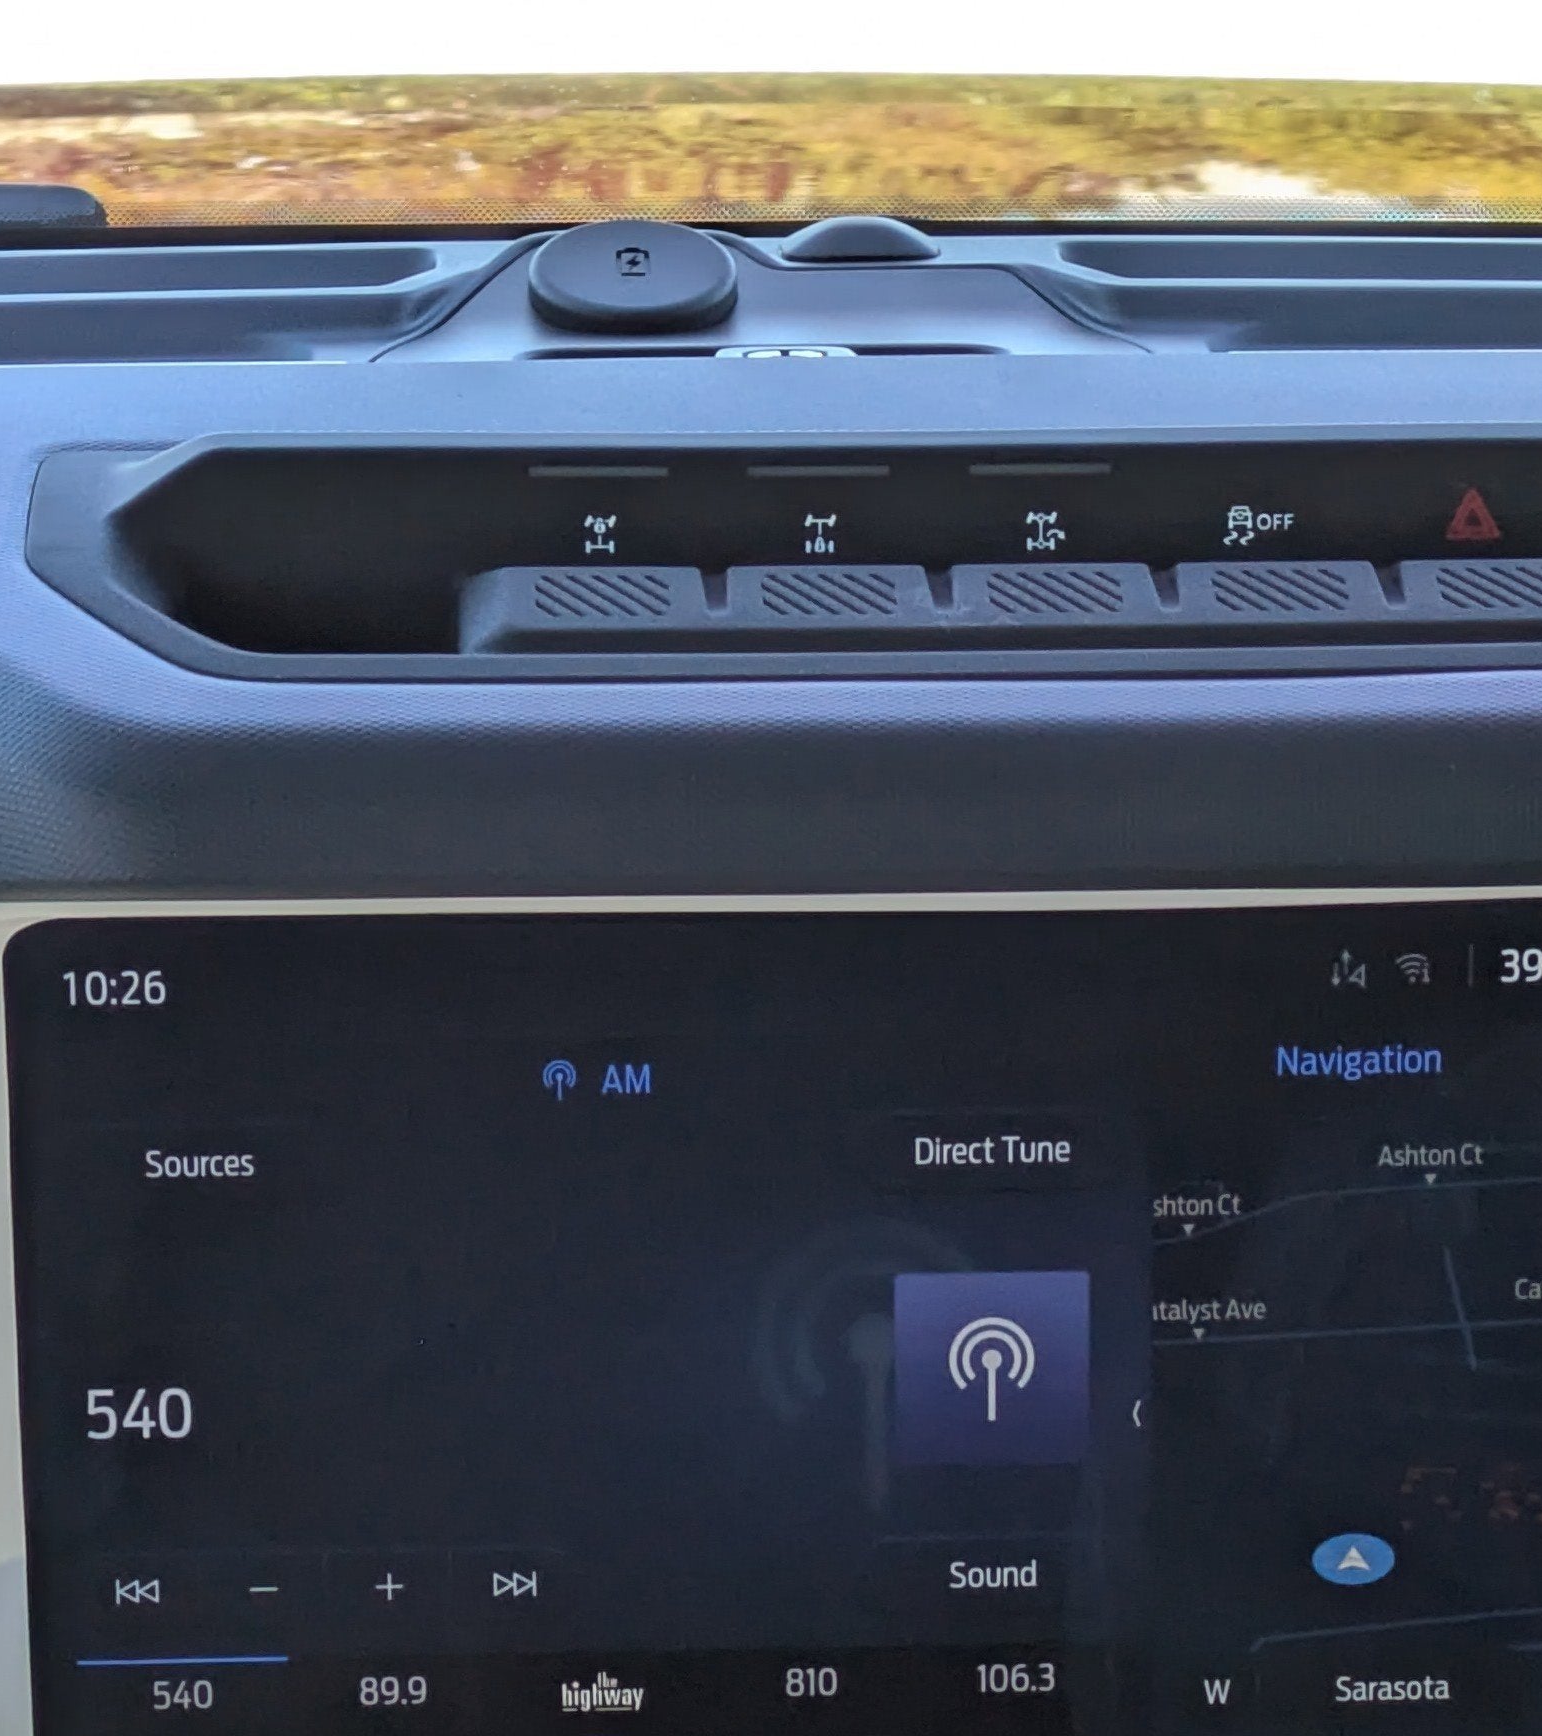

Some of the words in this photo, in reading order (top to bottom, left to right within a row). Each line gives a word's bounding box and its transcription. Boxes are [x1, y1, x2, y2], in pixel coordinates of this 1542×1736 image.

[1255, 512, 1294, 531] OFF
[62, 969, 166, 1006] 10:26
[1276, 1044, 1442, 1081] Navigation
[601, 1063, 651, 1094] AM
[145, 1149, 255, 1179] Sources
[914, 1136, 996, 1165] Direct
[1000, 1135, 1071, 1164] Tune
[1377, 1144, 1457, 1167] Ashton
[1458, 1142, 1483, 1166] Ct
[1152, 1194, 1214, 1217] shton
[1216, 1193, 1241, 1217] Ct
[1151, 1299, 1221, 1326] talyst
[1224, 1298, 1267, 1320] Ave
[87, 1387, 192, 1440] 540
[949, 1558, 1037, 1589] Sound
[359, 1675, 427, 1706] 89.9
[785, 1666, 838, 1697] 810
[977, 1662, 1056, 1693] 106.3
[1203, 1678, 1231, 1705] W
[1335, 1675, 1450, 1702] Sarasota
[153, 1679, 213, 1710] 540
[561, 1679, 644, 1712] highway
